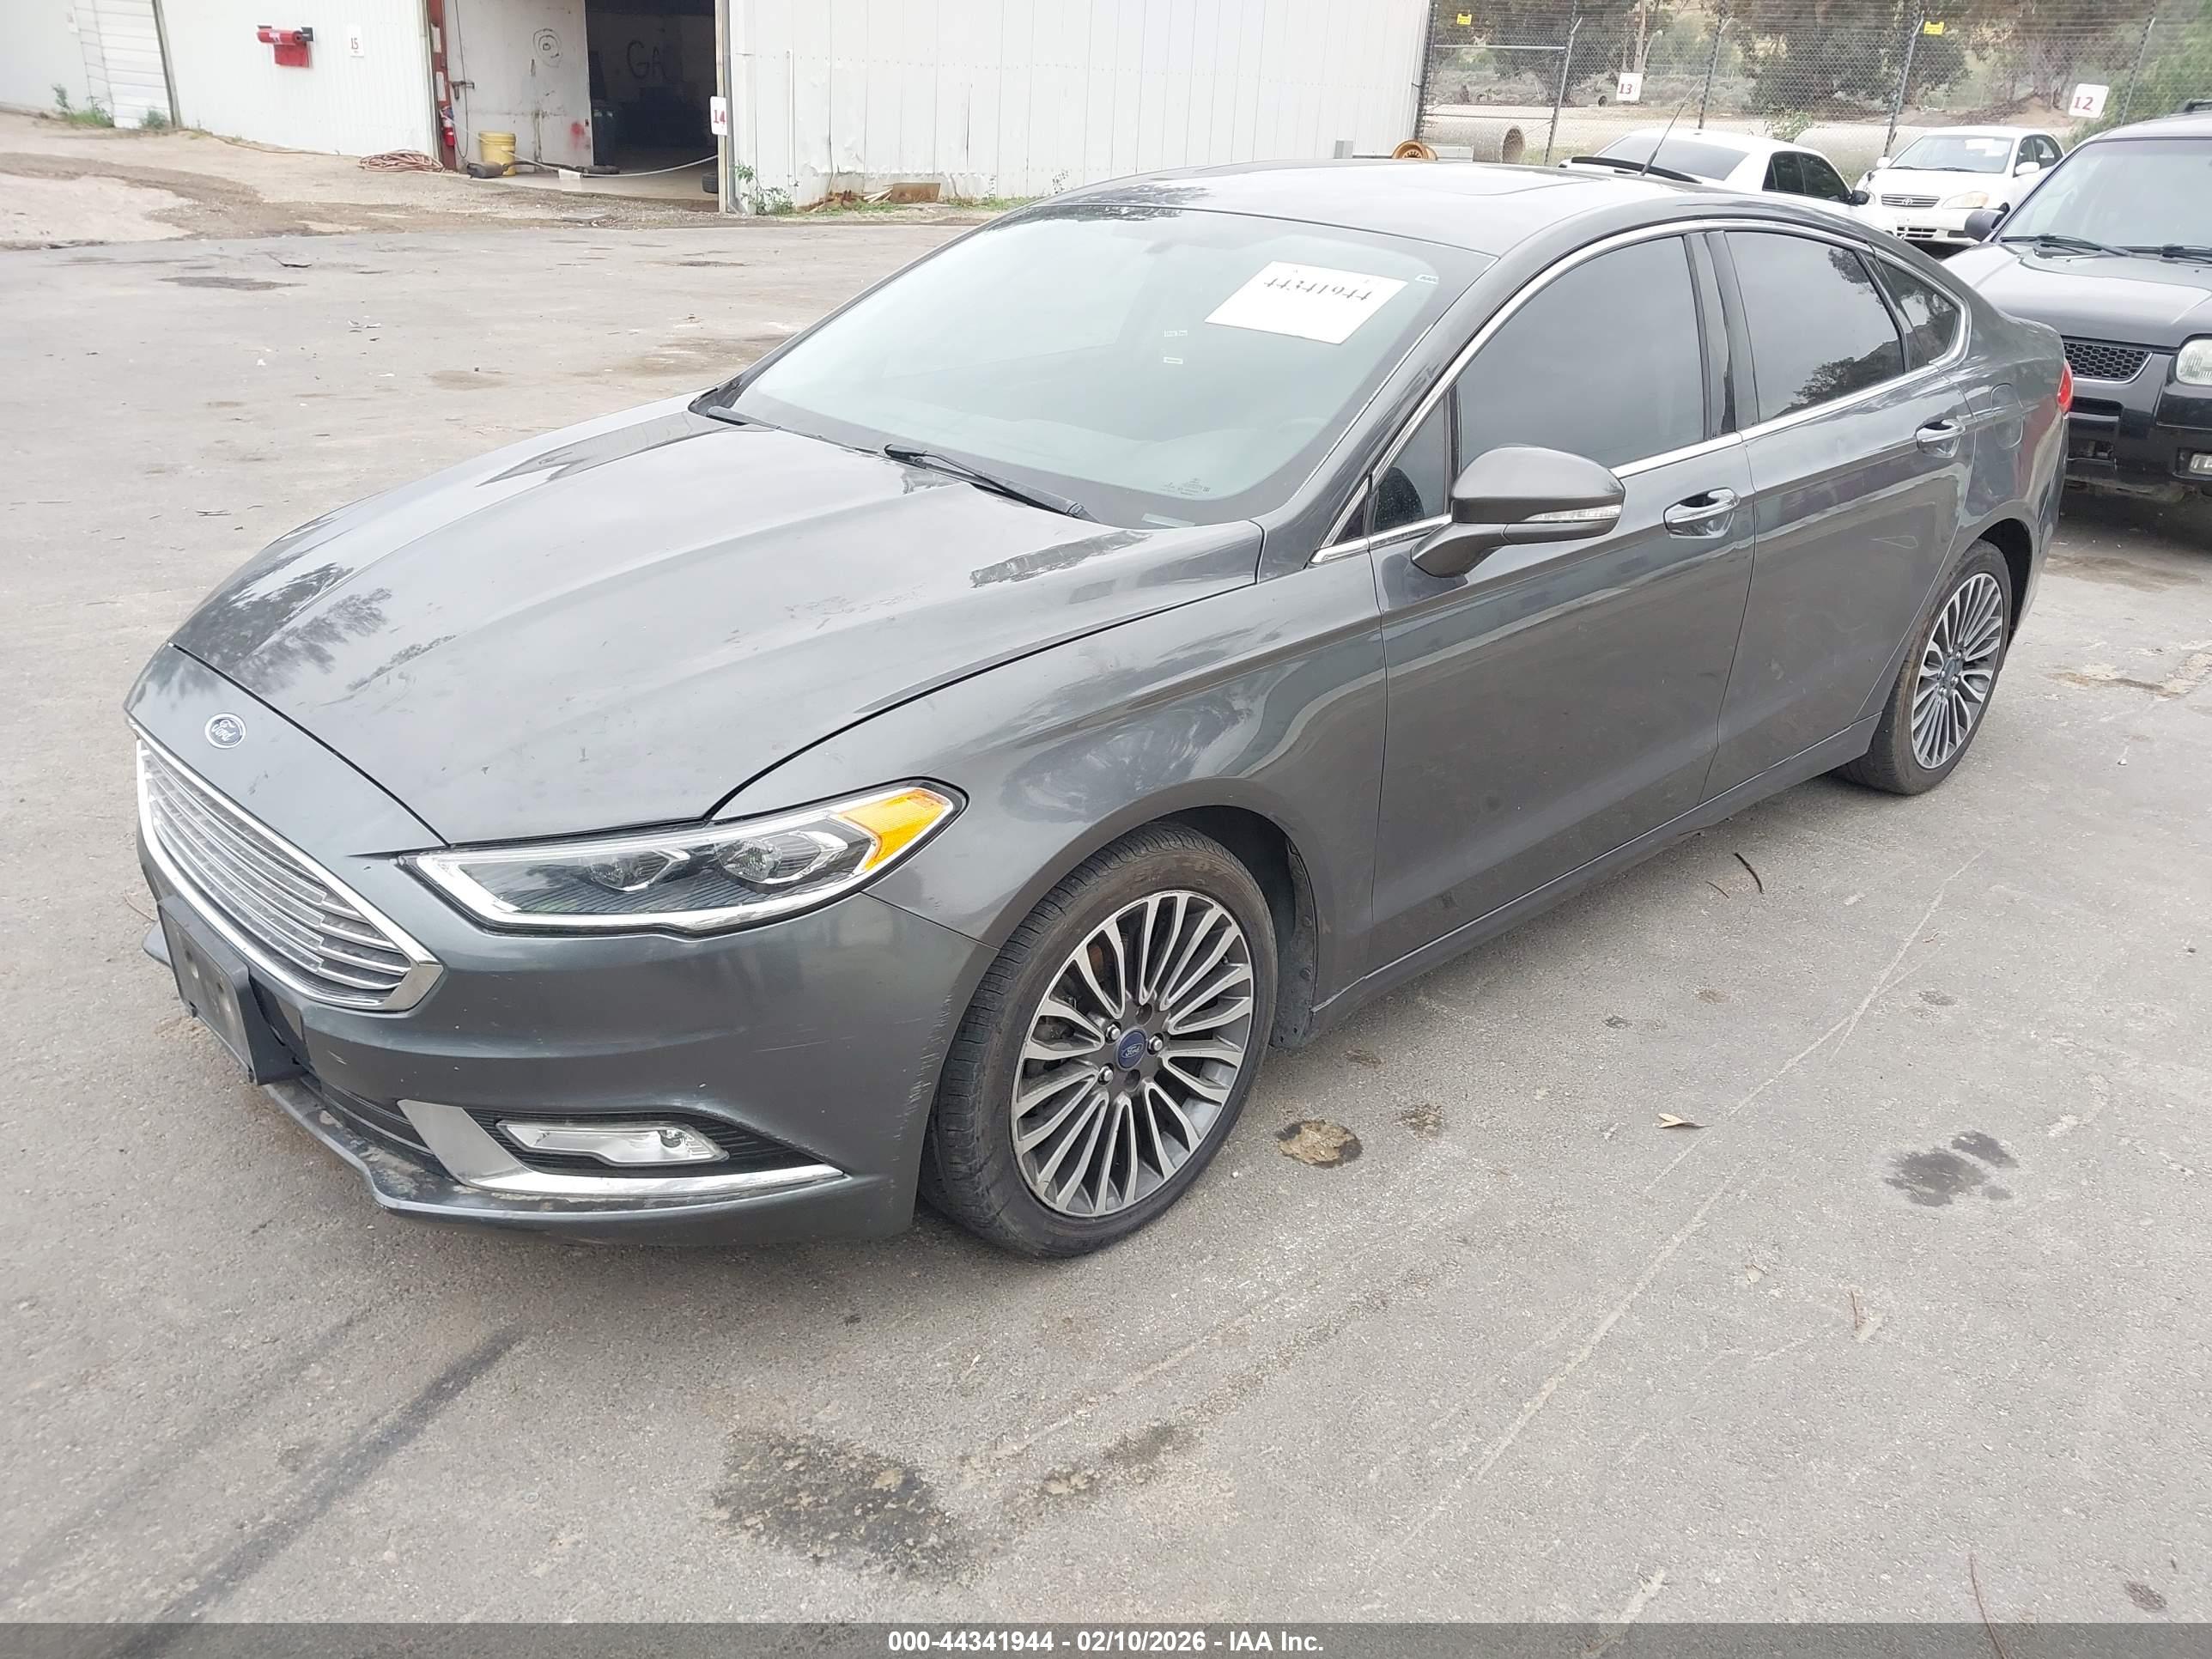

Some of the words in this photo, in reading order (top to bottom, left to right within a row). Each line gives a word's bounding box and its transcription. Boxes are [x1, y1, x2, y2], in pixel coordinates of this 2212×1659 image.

[350, 38, 359, 50] 15
[1619, 83, 1632, 94] 13
[2074, 96, 2094, 111] 12
[713, 109, 726, 125] 14
[210, 719, 237, 742] Ford
[1125, 1045, 1141, 1057] Ford
